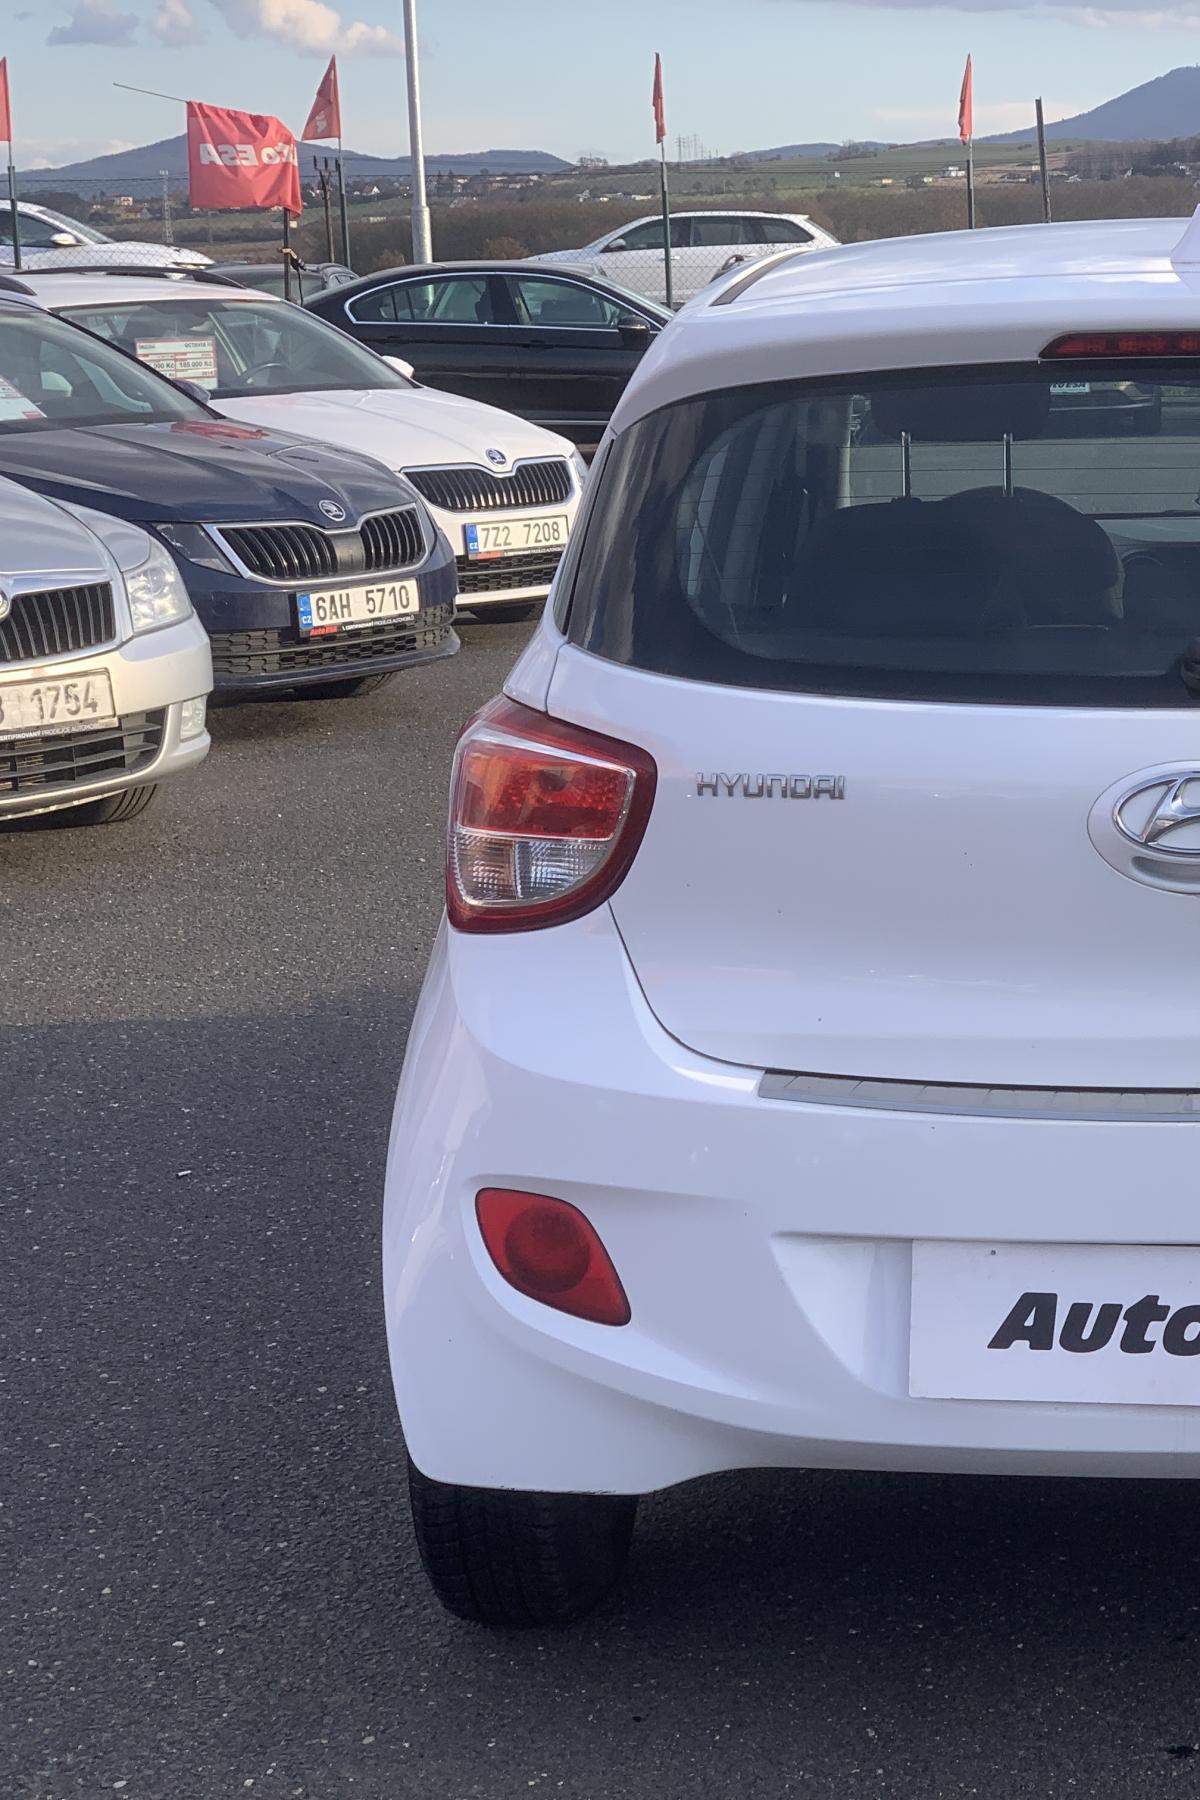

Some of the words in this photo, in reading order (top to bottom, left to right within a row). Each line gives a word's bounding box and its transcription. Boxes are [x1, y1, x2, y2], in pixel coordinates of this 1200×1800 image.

[481, 526, 512, 549] 7Z2
[523, 521, 561, 545] 7208
[302, 615, 311, 624] CZ
[316, 592, 352, 622] 6AH
[365, 585, 410, 615] 5710
[31, 681, 98, 719] 1754
[697, 772, 846, 800] HYUNDAI
